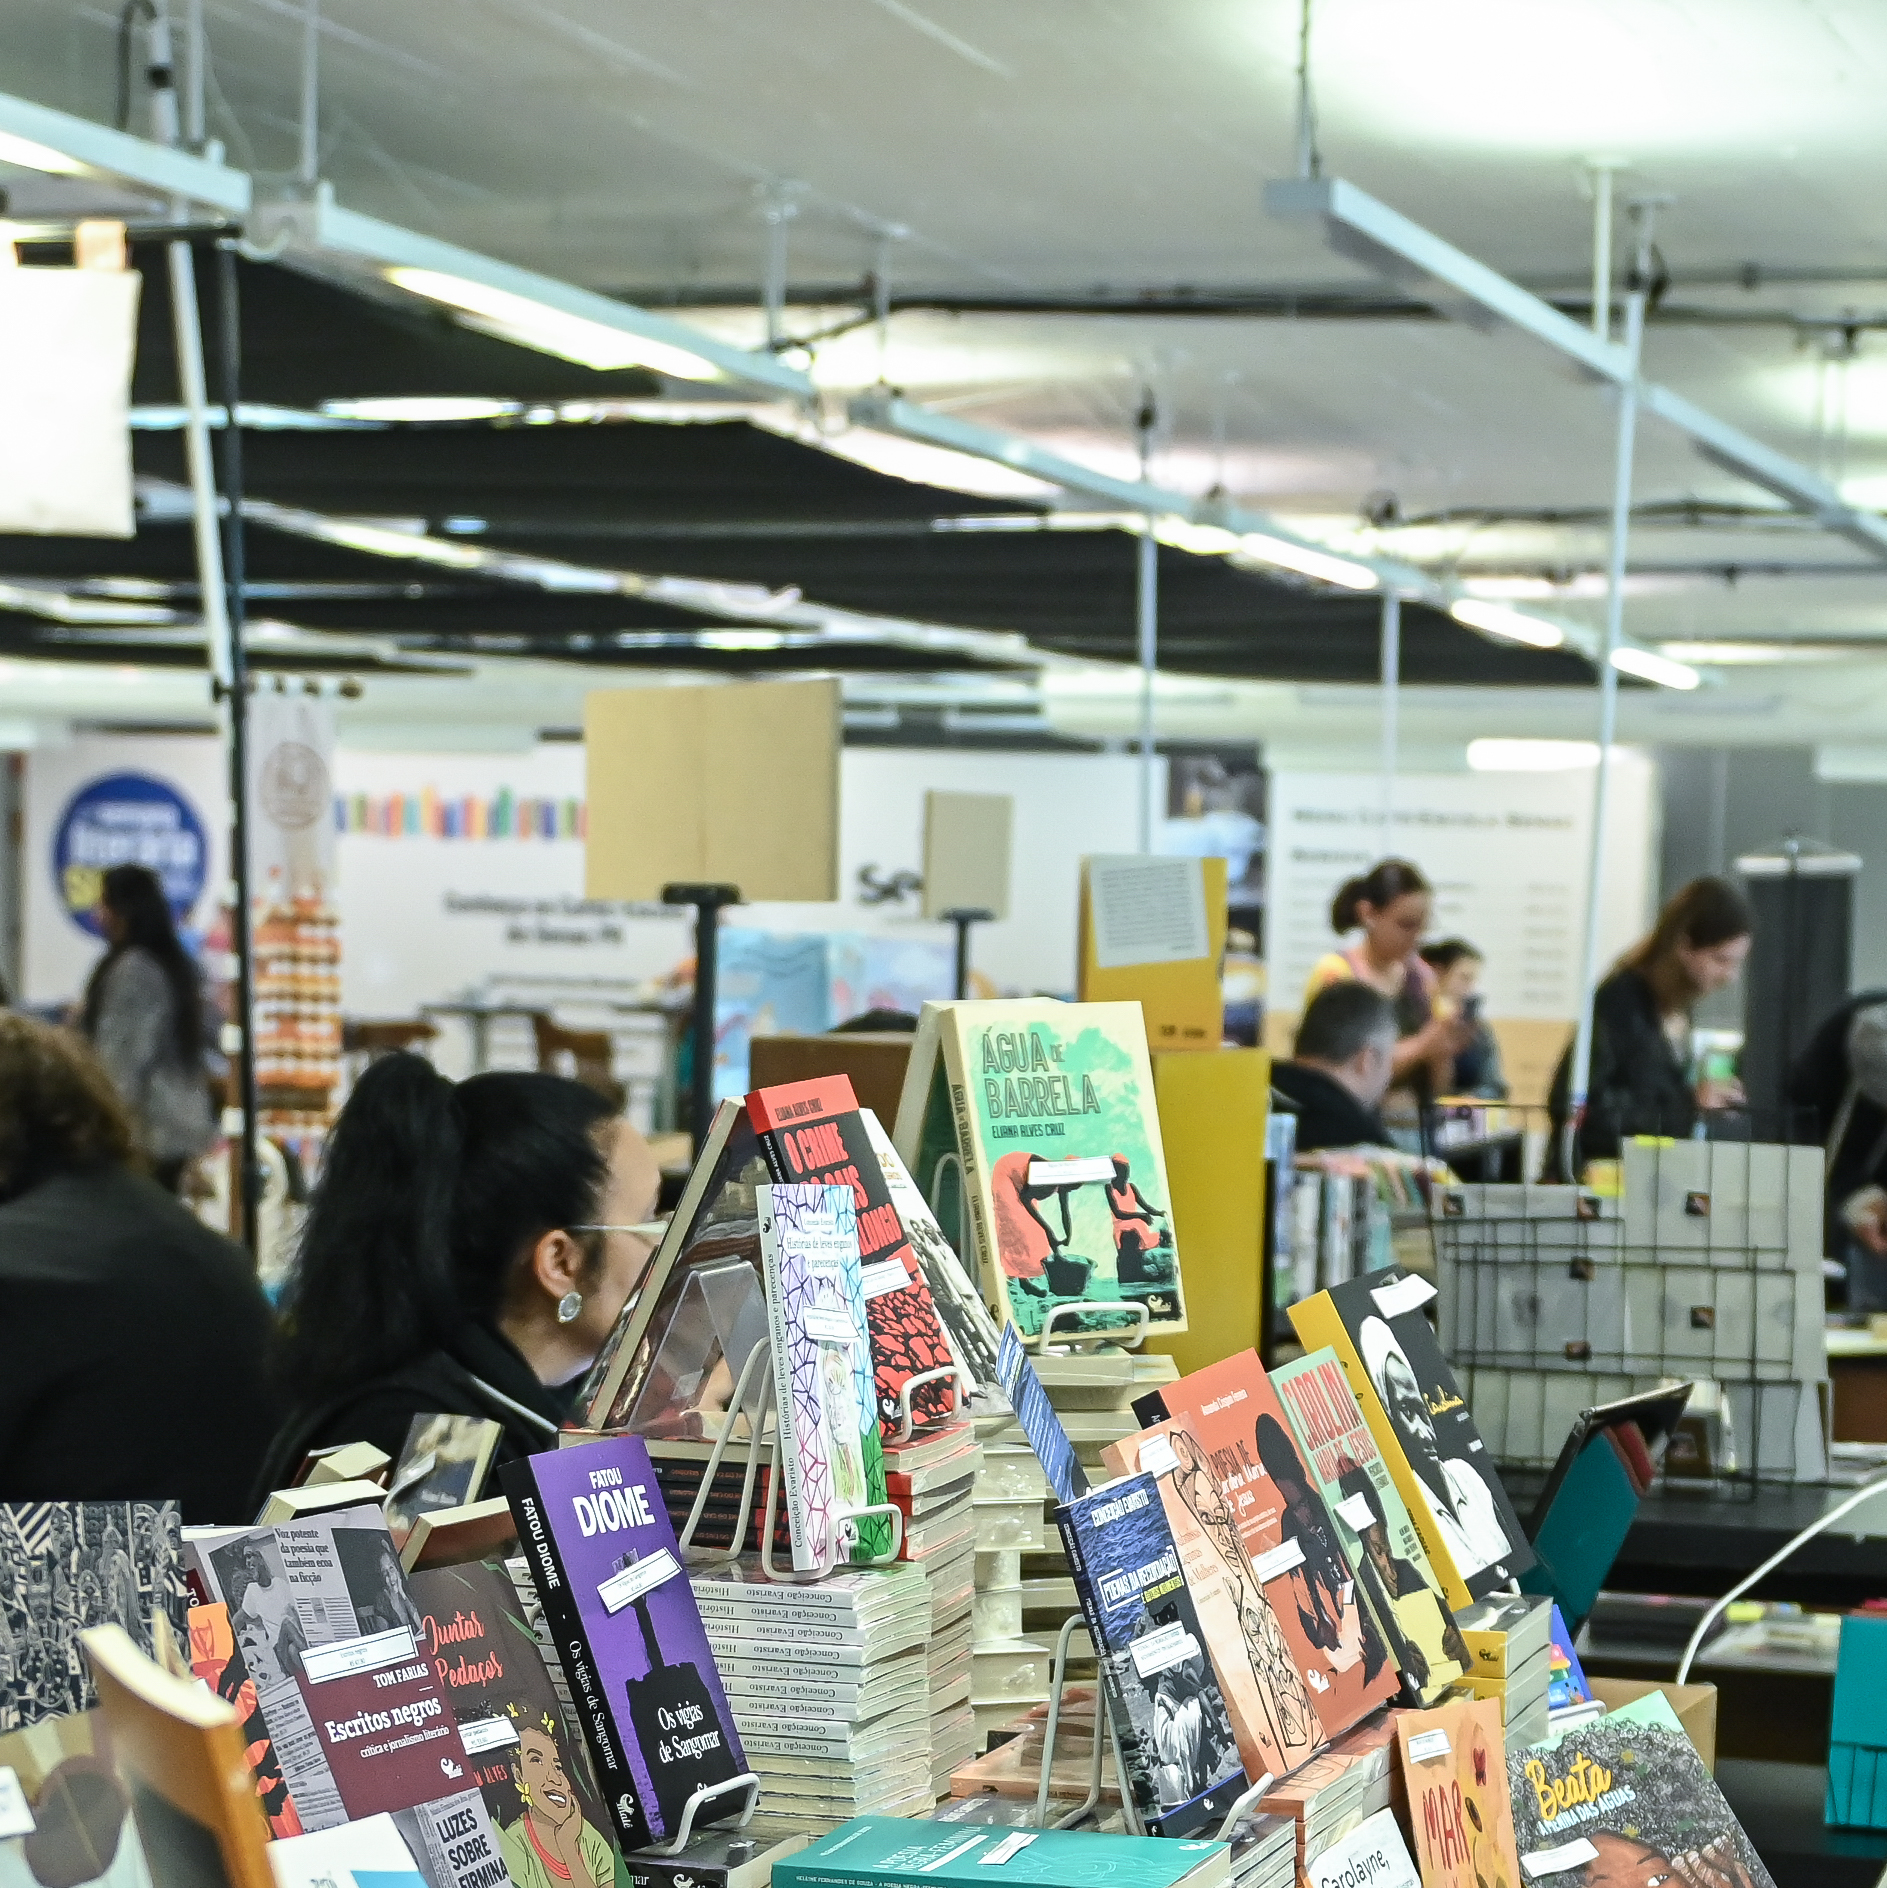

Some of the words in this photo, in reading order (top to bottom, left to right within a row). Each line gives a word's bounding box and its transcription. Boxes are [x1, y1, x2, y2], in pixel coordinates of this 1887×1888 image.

[982, 1026, 1050, 1075] ÁGUA
[985, 1074, 1102, 1119] BARRELA
[992, 1125, 1020, 1139] ELIANA
[1020, 1123, 1044, 1138] ALVES
[1045, 1122, 1066, 1137] CRUZ
[767, 1252, 781, 1306] parecenças
[772, 1314, 785, 1355] enganos
[778, 1355, 786, 1384] leves
[779, 1384, 787, 1398] de
[781, 1398, 792, 1441] Histórias
[588, 1465, 623, 1490] FATOU
[788, 1456, 799, 1501] Evaristo
[572, 1484, 656, 1538] DIOME
[791, 1502, 804, 1549] Conceição
[280, 1542, 290, 1554] da
[290, 1543, 315, 1556] poesia
[314, 1544, 329, 1556] que
[521, 1497, 545, 1543] FATOU
[536, 1540, 561, 1590] DIOME
[284, 1557, 316, 1569] também
[316, 1558, 334, 1569] ecoa
[289, 1573, 299, 1584] na
[299, 1571, 323, 1585] ficção
[746, 1587, 786, 1600] Evaristo
[786, 1590, 833, 1605] Conceição
[751, 1605, 790, 1619] Evaristo
[791, 1609, 838, 1623] Conceição
[422, 1610, 485, 1656] Juntar
[756, 1624, 795, 1638] Evaristo
[797, 1627, 844, 1642] Conceição
[568, 1640, 583, 1660] Os
[753, 1643, 792, 1657] Evaristo
[793, 1646, 841, 1661] Conceição
[373, 1670, 395, 1689] TOM
[394, 1662, 430, 1685] FARIAS
[434, 1650, 504, 1689] Pedaços
[575, 1659, 593, 1695] vigias
[587, 1693, 599, 1712] de
[657, 1705, 677, 1731] Os
[676, 1701, 704, 1731] vigias
[324, 1709, 392, 1744] Escritos
[391, 1697, 443, 1727] negros
[741, 1717, 779, 1732] Evaristo
[780, 1721, 827, 1735] Conceição
[360, 1745, 383, 1759] crítica
[388, 1734, 424, 1754] jornalismo
[423, 1724, 451, 1741] literário
[592, 1711, 618, 1772] Sangomar
[658, 1742, 674, 1764] de
[671, 1728, 720, 1762] Sangomar
[743, 1737, 782, 1751] Evaristo
[783, 1740, 830, 1755] Conceição
[483, 1763, 509, 1784] ALVES
[1525, 1750, 1614, 1822] Beata
[436, 1806, 479, 1844] LUZES
[1422, 1778, 1472, 1871] MAR
[1536, 1820, 1549, 1837] A
[1543, 1808, 1582, 1834] MENINA
[1575, 1801, 1600, 1822] DAS
[447, 1833, 493, 1872] SOBRE
[856, 1879, 874, 1887] SOUZA
[883, 1881, 902, 1888] POESIA
